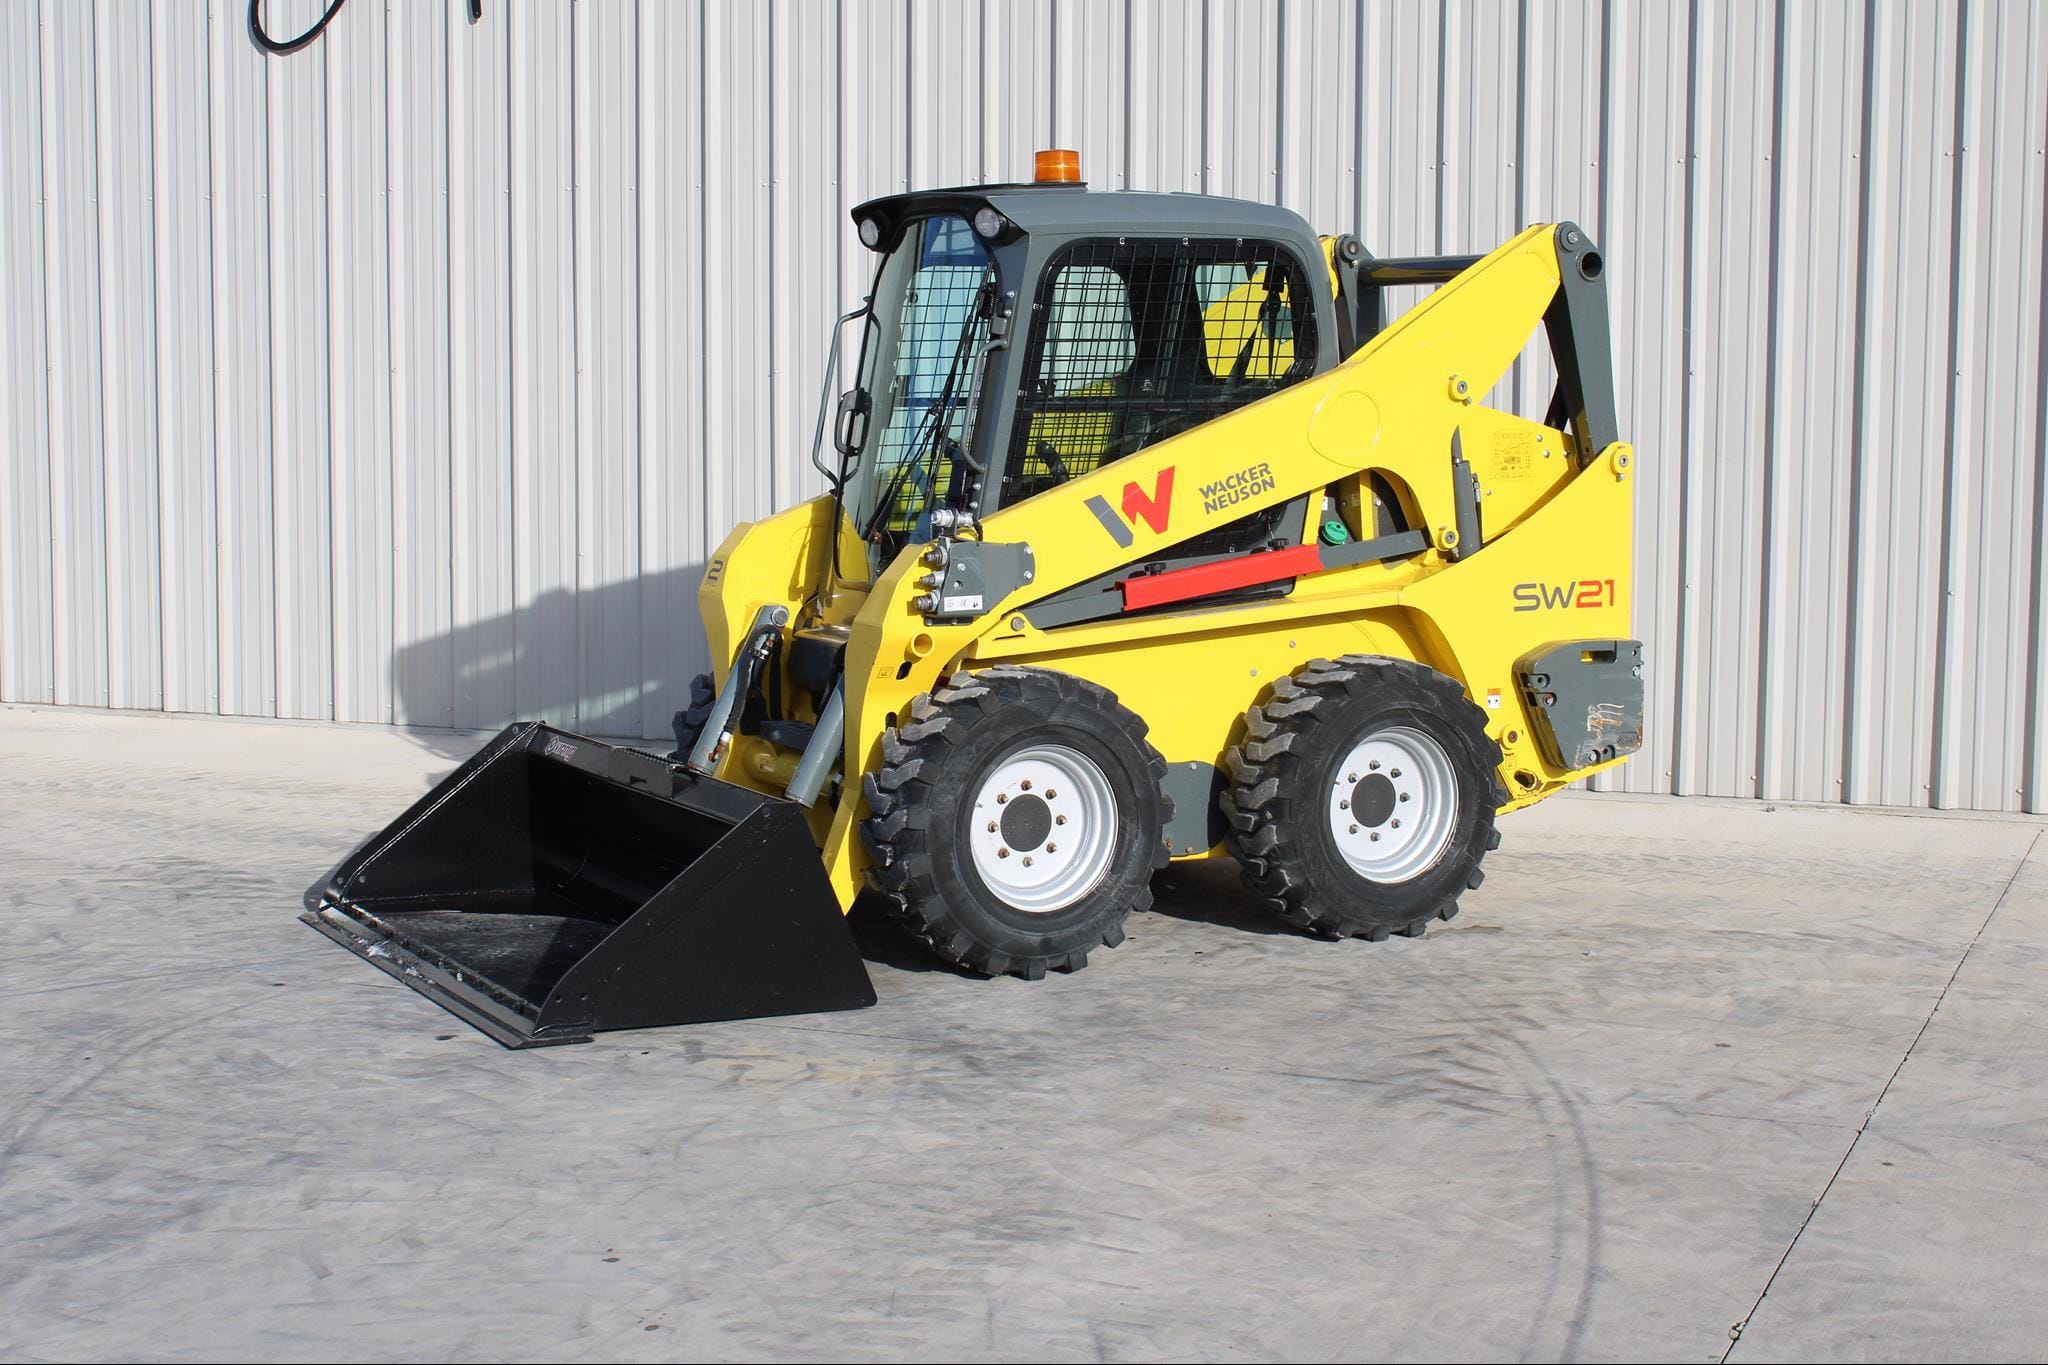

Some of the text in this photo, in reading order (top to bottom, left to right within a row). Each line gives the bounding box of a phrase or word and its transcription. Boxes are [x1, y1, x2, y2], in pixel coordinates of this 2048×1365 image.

[1199, 462, 1272, 499] WACKER
[1203, 475, 1276, 515] NEUSON
[1512, 579, 1615, 612] SW21
